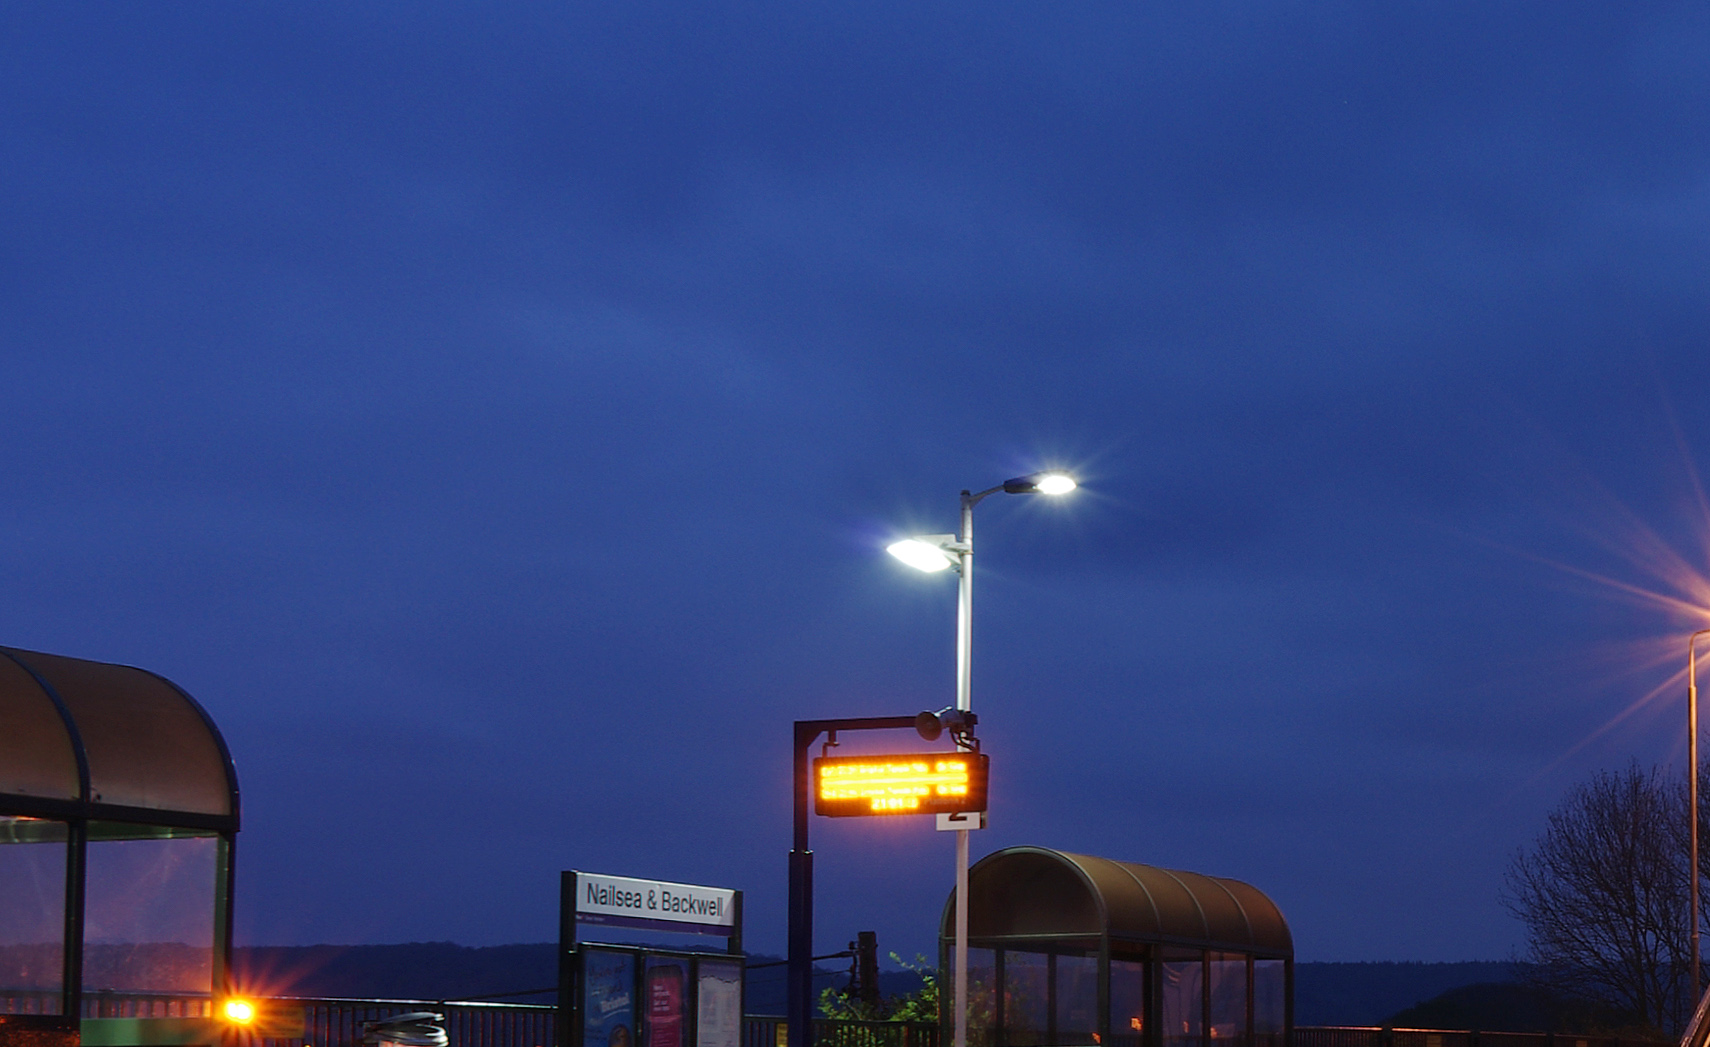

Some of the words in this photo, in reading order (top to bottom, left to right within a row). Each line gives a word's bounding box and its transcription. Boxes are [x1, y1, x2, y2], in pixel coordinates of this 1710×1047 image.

[587, 882, 642, 909] Nailsea
[647, 888, 658, 911] &
[662, 890, 724, 917] Backwell
